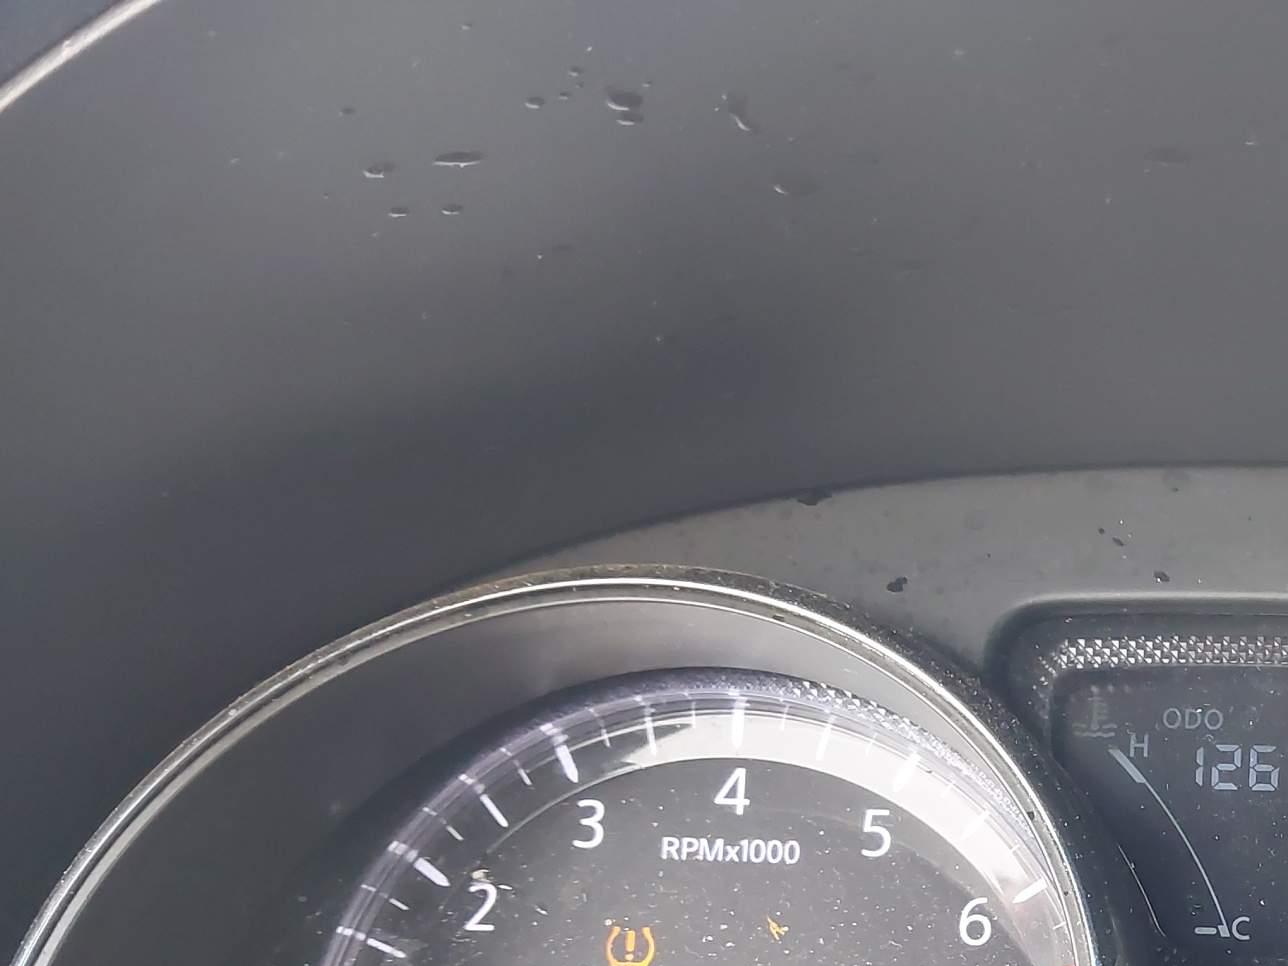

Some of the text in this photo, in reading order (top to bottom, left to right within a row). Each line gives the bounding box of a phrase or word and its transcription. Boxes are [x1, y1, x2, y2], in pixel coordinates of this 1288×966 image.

[1163, 709, 1223, 730] ODO
[1129, 734, 1150, 757] H
[715, 768, 750, 815] 4
[573, 799, 605, 849] 3
[861, 808, 892, 857] 5
[660, 836, 801, 865] RPMx1000
[464, 883, 495, 932] 2
[958, 897, 993, 946] 6
[1232, 917, 1250, 941] C
